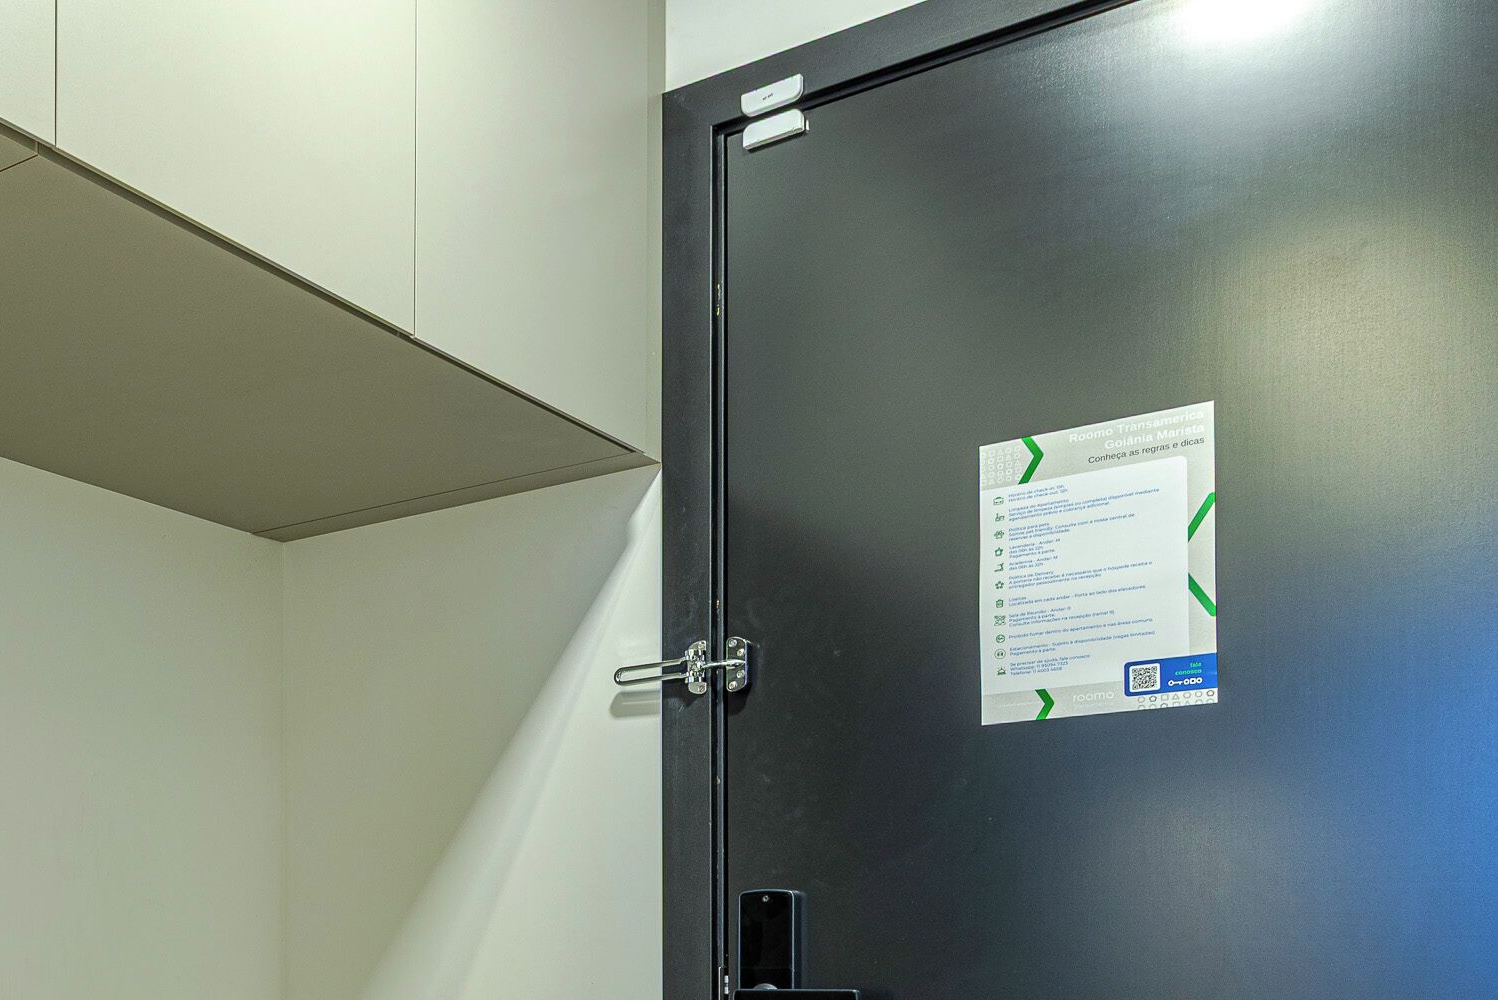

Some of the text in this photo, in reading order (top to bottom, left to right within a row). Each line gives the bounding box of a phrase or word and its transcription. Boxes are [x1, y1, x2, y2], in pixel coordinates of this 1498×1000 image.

[1069, 412, 1203, 443] Roomo Transamerica
[1104, 424, 1203, 450] Goiânia Marista
[1088, 451, 1127, 464] Conheça
[1129, 449, 1140, 457] as
[1142, 444, 1170, 455] regras
[1180, 436, 1204, 448] dicas
